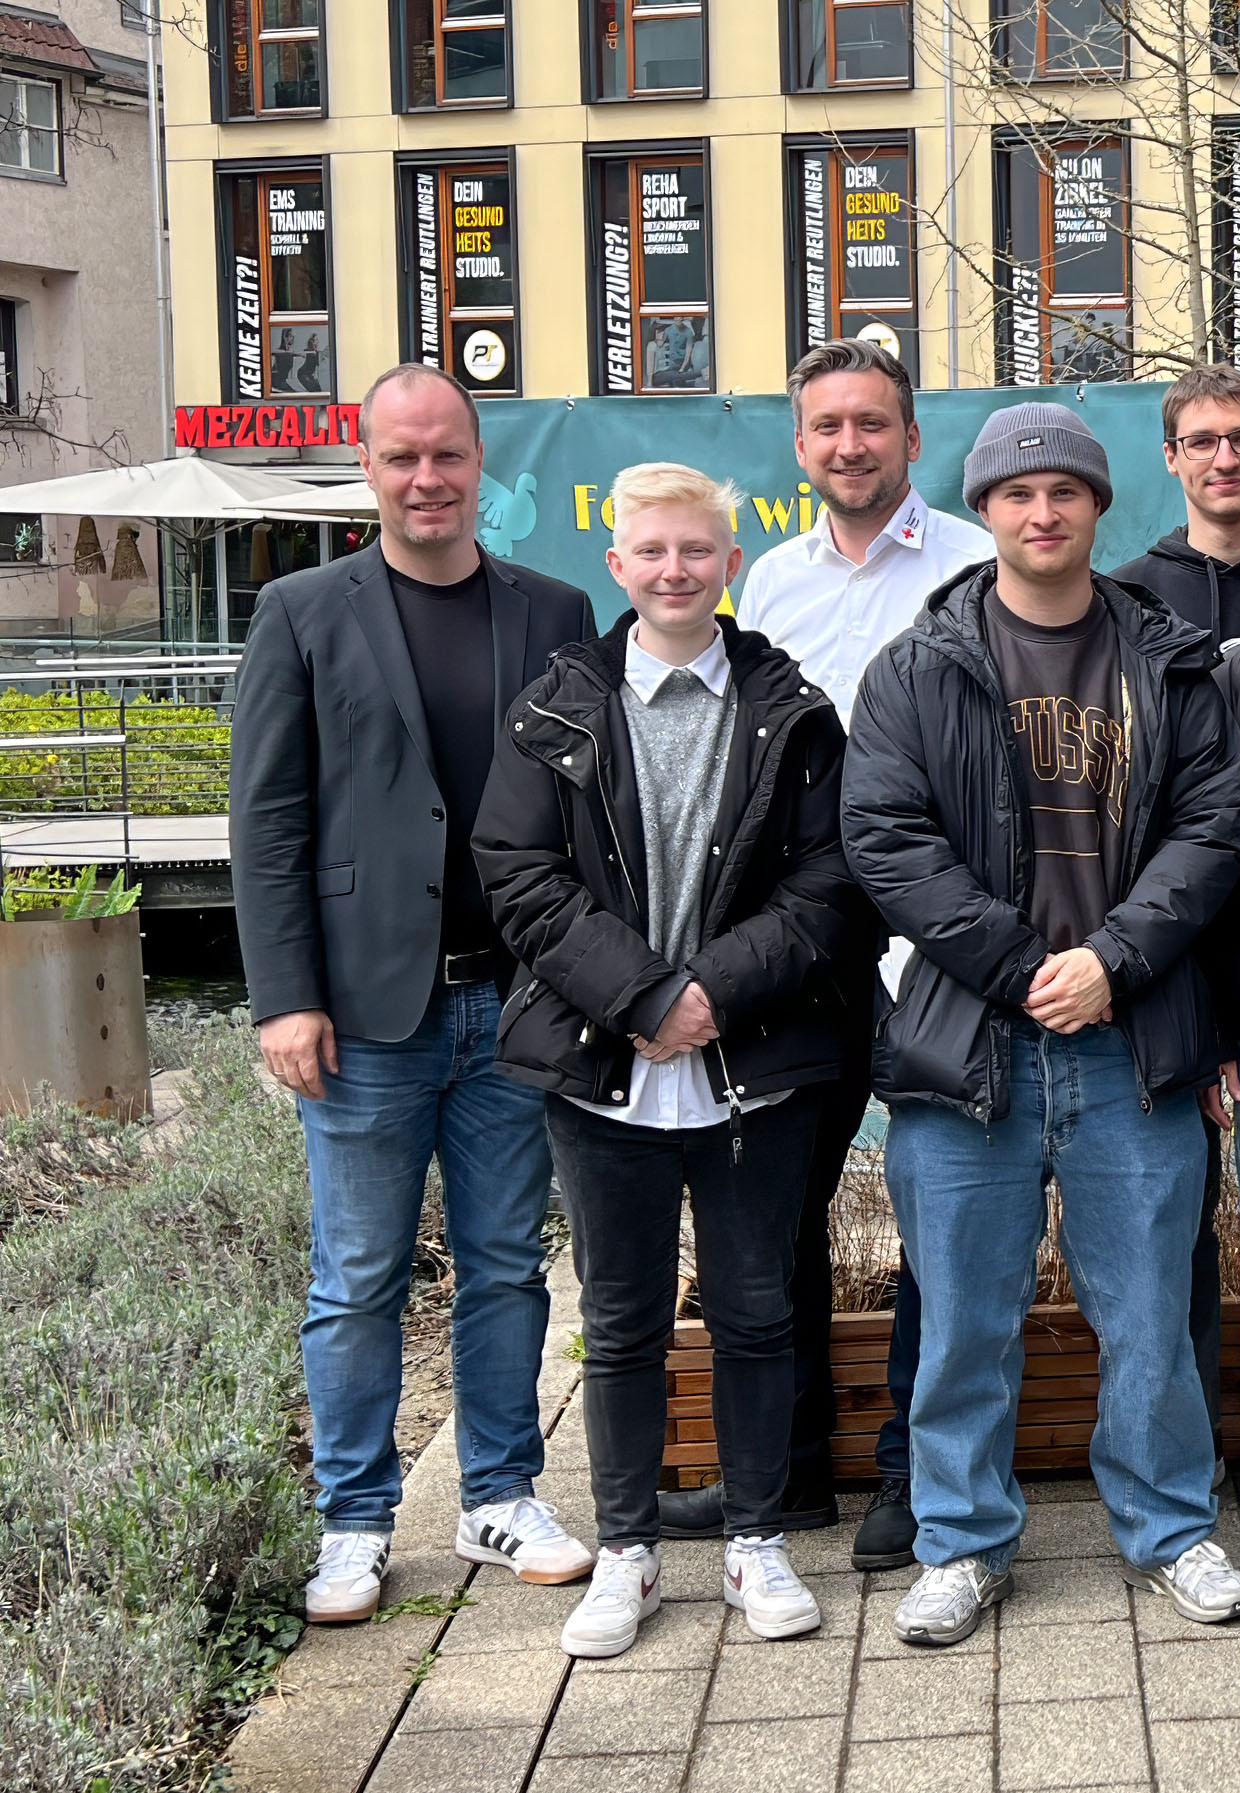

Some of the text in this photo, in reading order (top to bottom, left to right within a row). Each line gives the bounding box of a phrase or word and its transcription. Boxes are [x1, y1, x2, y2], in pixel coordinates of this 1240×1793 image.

[642, 174, 679, 195] REHA
[845, 166, 877, 188] DEIN
[269, 189, 296, 210] EMS
[454, 181, 483, 202] DEIN
[642, 196, 688, 218] SPORT
[846, 192, 900, 214] GESUND
[269, 210, 325, 232] TRAINING
[417, 173, 437, 269] REUTLINGEN
[455, 206, 504, 228] GESUND
[847, 219, 886, 241] HEITS
[456, 231, 491, 253] HEITS
[804, 160, 826, 347] TRAINIERT REUTLINGEN
[846, 246, 900, 268] STUDIO.
[456, 256, 505, 278] STUDIO.
[420, 270, 439, 352] TRAINIERT
[604, 223, 632, 390] VERLETZUNG?!
[236, 256, 262, 398] KEINE ZEIT?!
[752, 482, 827, 534] wi
